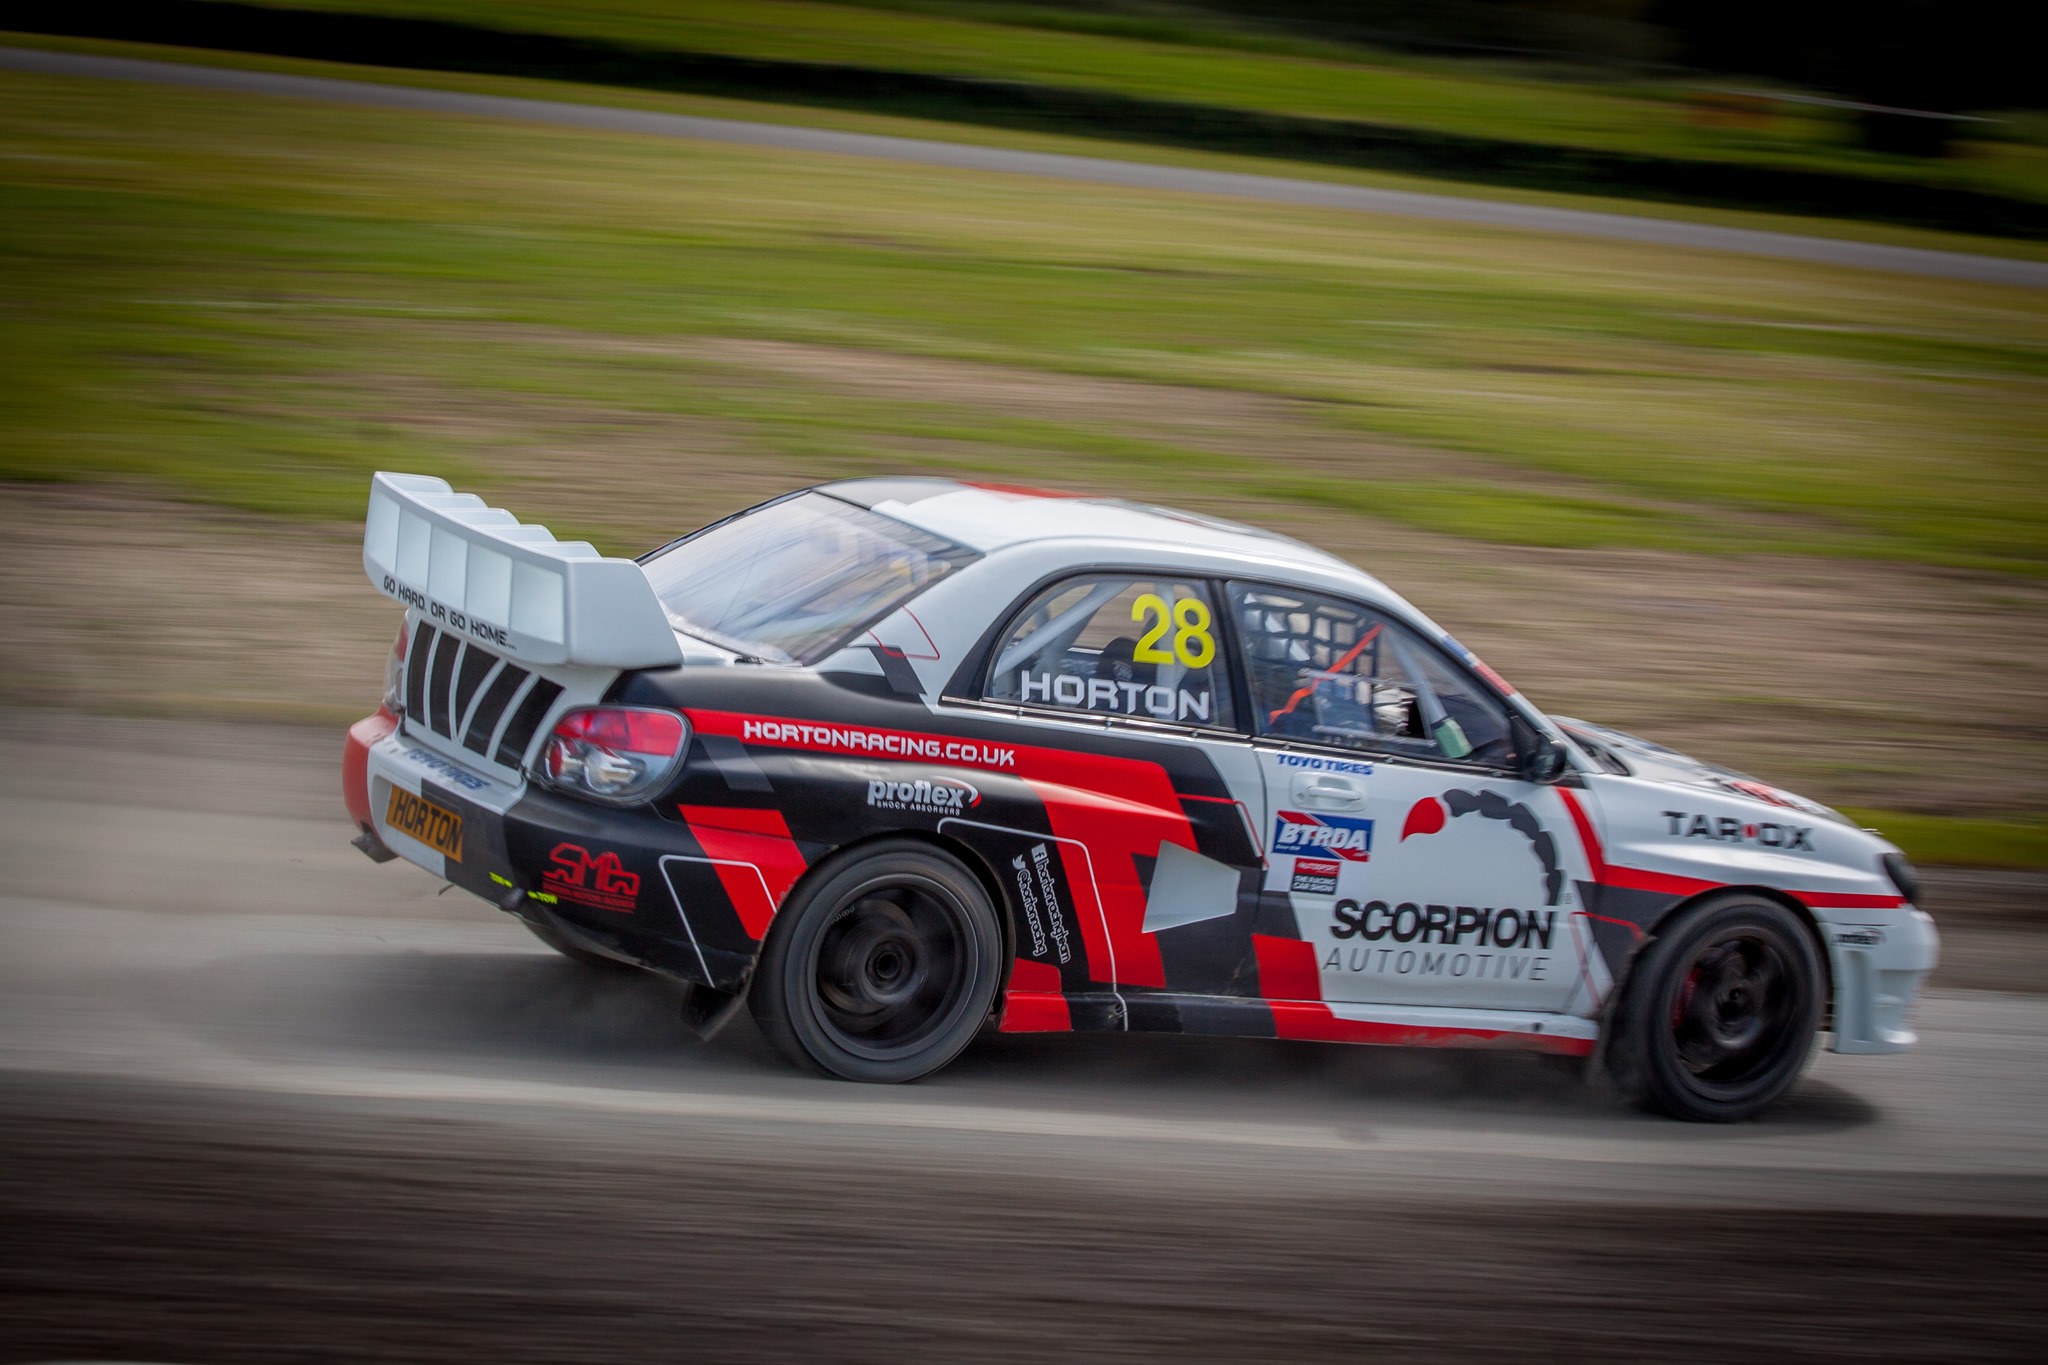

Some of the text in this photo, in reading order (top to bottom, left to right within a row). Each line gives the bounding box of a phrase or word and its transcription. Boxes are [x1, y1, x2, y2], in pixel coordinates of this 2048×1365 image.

[383, 574, 396, 595] GO
[430, 601, 446, 623] OR
[450, 611, 466, 630] GO
[1131, 593, 1216, 669] 28
[1021, 669, 1210, 721] HORTON
[743, 720, 1015, 767] HORTONRACING.CO.UK
[1277, 754, 1374, 775] TOYO TIRES
[867, 779, 965, 808] proflex
[876, 800, 961, 816] SHOCK ABSORBERS
[392, 789, 461, 855] HORTON
[1277, 822, 1370, 851] BTRDA
[1017, 868, 1047, 957] @hortonracing
[1036, 858, 1071, 965] hortonracingteam
[1329, 898, 1556, 949] SCORPION
[1322, 947, 1551, 981] AUTOMOTIVE
